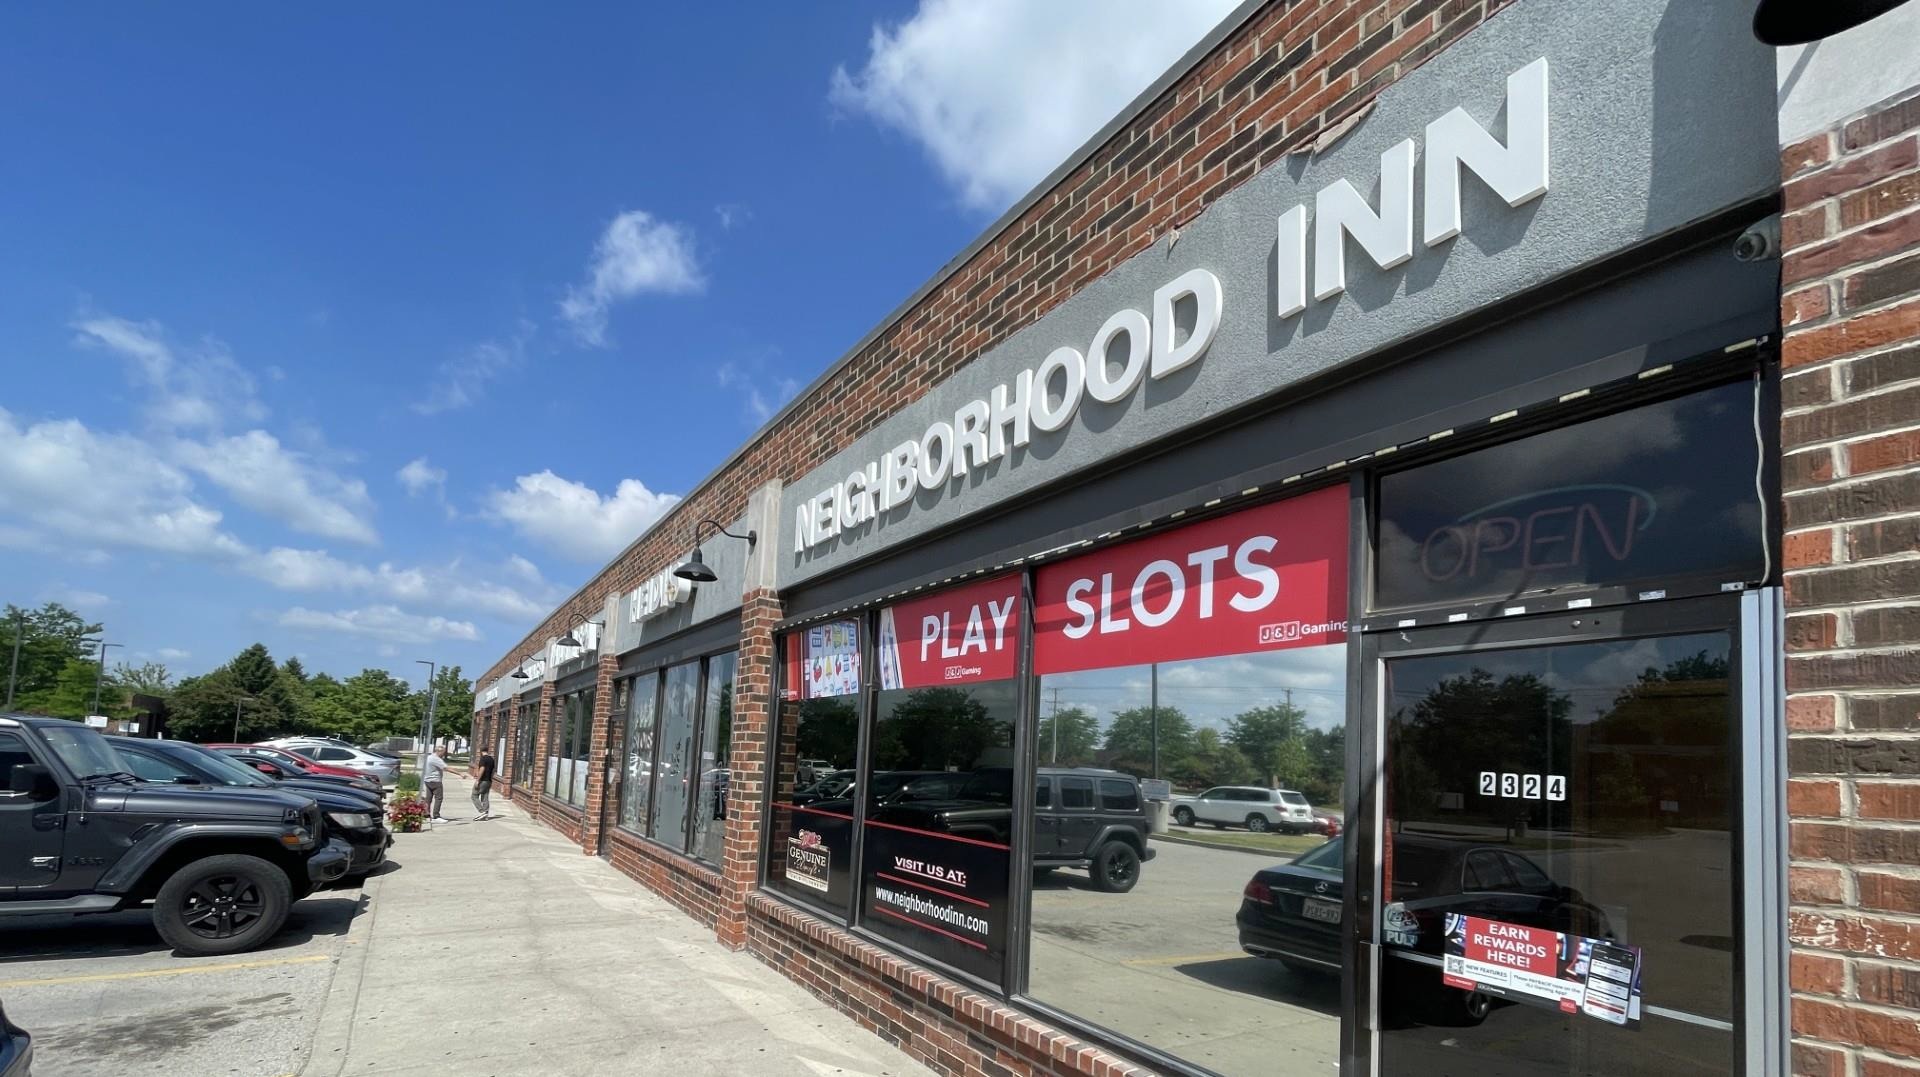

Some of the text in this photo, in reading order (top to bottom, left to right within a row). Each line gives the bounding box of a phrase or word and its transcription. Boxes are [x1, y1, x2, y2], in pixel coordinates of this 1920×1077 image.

[795, 56, 1549, 553] NEIGHBORHOOD INN
[1420, 495, 1640, 583] OPEN
[1062, 535, 1280, 639] SLOTS
[920, 595, 1016, 662] PLAY
[1261, 622, 1299, 642] J&J
[1481, 773, 1564, 800] 2324
[789, 846, 826, 867] GENUINE
[894, 856, 967, 884] VISIT US AT:
[875, 886, 988, 935] www.neighborhoodinn.com
[1473, 933, 1547, 958] REWARDS
[1489, 923, 1530, 942] EARN
[1487, 949, 1530, 969] HERE!
